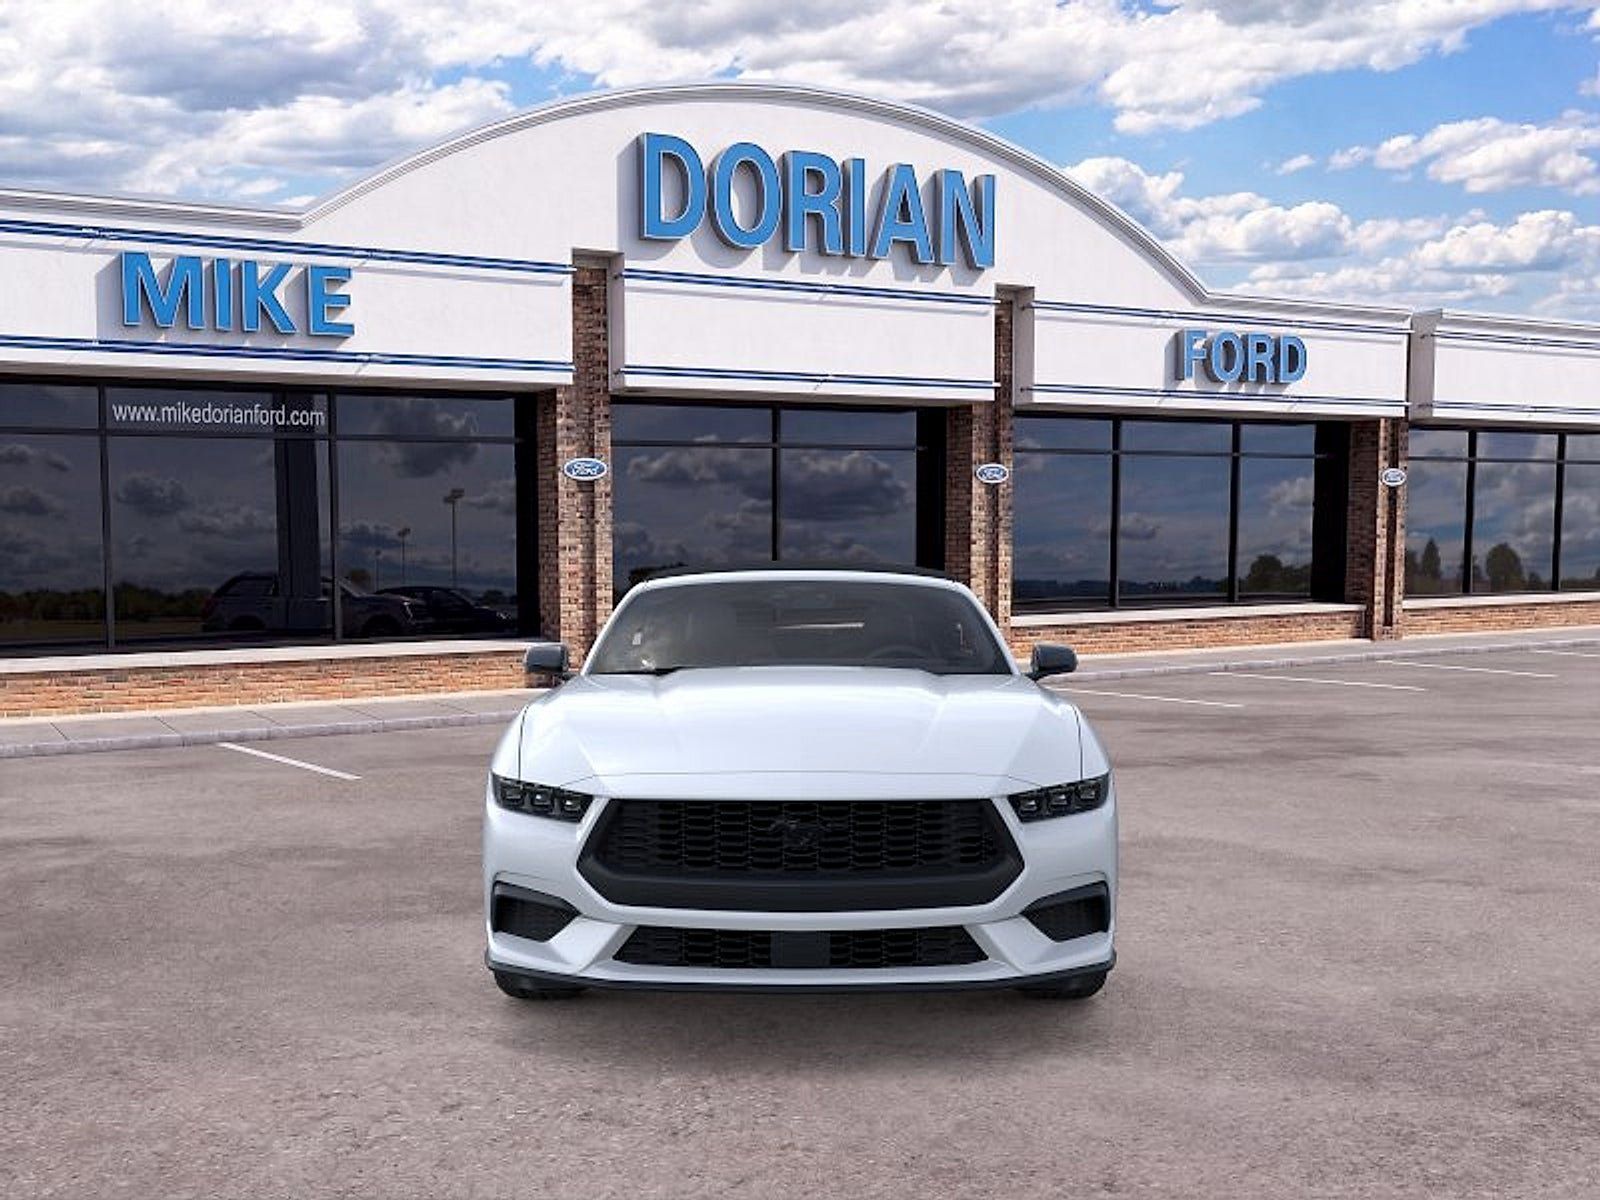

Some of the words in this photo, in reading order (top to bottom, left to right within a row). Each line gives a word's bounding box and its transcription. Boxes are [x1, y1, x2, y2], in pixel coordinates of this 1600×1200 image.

[639, 132, 996, 269] DORIAN
[120, 251, 355, 336] MIKE
[1177, 328, 1308, 384] FORD
[112, 402, 326, 427] www.mikedorianford.com
